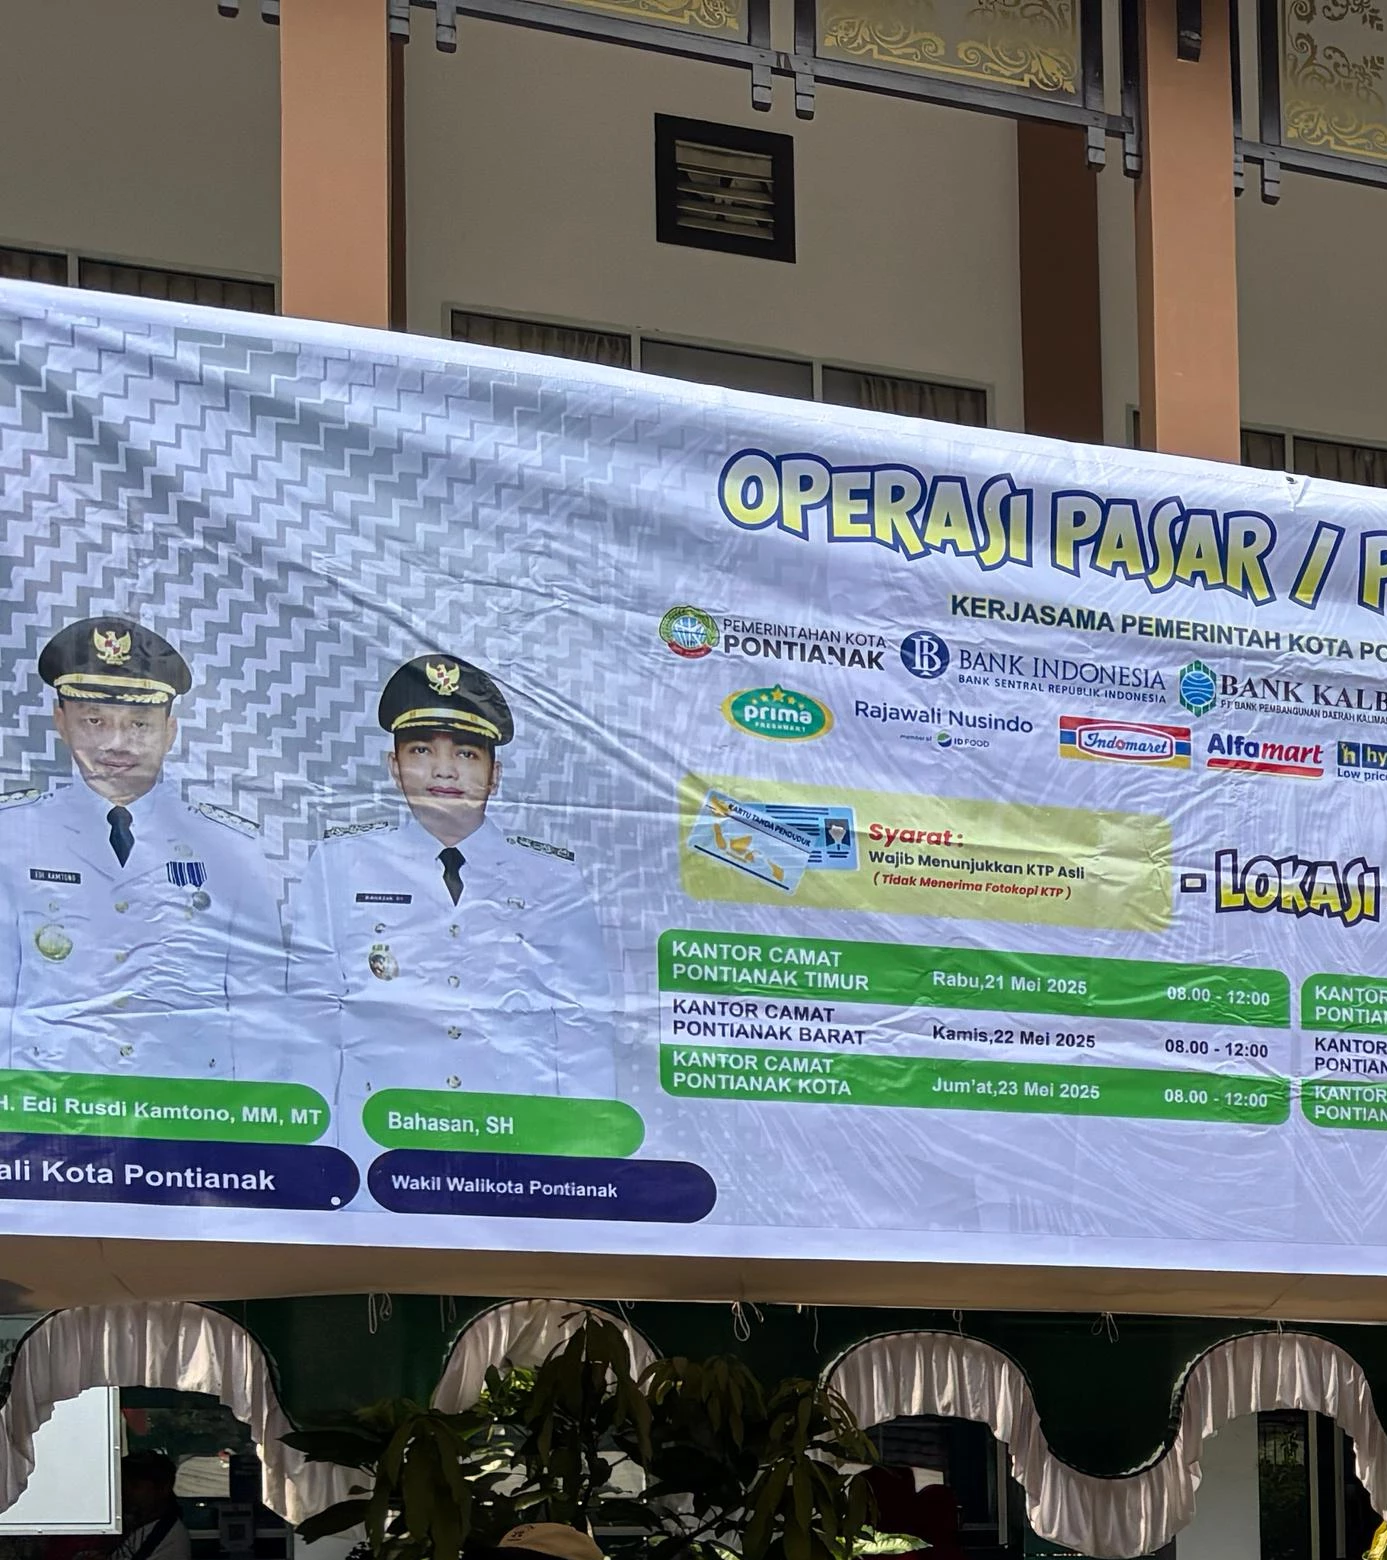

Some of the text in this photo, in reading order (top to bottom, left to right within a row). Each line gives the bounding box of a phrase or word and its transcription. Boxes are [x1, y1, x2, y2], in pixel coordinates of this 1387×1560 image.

[718, 447, 1033, 571] OPERASI
[1051, 490, 1276, 606] PASAR
[1289, 521, 1345, 609] /
[723, 618, 887, 648] PEMERINTAHAN KOTA
[952, 595, 1114, 632] KERJASAMA
[1122, 614, 1280, 650] PEMERINTAH
[1289, 634, 1350, 659] KOTA
[724, 634, 885, 671] PONTIANAK
[959, 649, 1166, 691] BANK INDONESIA
[959, 674, 1167, 704] BANK SENTRAL REPUBLIK INDONESIA
[1220, 674, 1303, 704] BANK
[743, 703, 813, 725] prima
[855, 700, 1033, 734] Rajawali Nusindo
[1259, 703, 1320, 718] PEMBANGUNAN
[1322, 709, 1355, 722] DAERAH
[1085, 732, 1167, 754] Indomaret
[1207, 734, 1323, 764] Alfamart
[1337, 768, 1360, 780] Low
[729, 803, 751, 820] KARTU
[752, 815, 775, 832] TANDA
[868, 851, 1085, 880] Wajib Menunjukkan KTP Asli
[882, 874, 1063, 898] Tidak Menerima Fotokopi KTP
[672, 941, 842, 968] KANTOR CAMAT
[673, 963, 869, 991] PONTIANAK TIMUR
[933, 971, 1270, 1006] Rabu,21 Mei 2025 08.00 12:00
[673, 999, 835, 1023] KANTOR CAMAT
[673, 1020, 866, 1045] PONTIANAK BARAT
[933, 1026, 1268, 1058] Kamis,22 Mei 2025 08.00 12:00
[1315, 1037, 1387, 1055] KANTOR
[673, 1051, 834, 1074] KANTOR CAMAT
[673, 1072, 852, 1096] PONTIANAK KOTA
[932, 1077, 1267, 1108] Jum'at,23 Mei 2025 08.00 12:00
[1315, 1086, 1387, 1103] KANTOR
[23, 1095, 322, 1126] Edi Rusdi Kamtono, MM, MT
[388, 1112, 513, 1136] Bahasan, SH
[42, 1161, 276, 1190] Kota Pontianak
[392, 1174, 618, 1198] Wakil Walikota Pontianak
